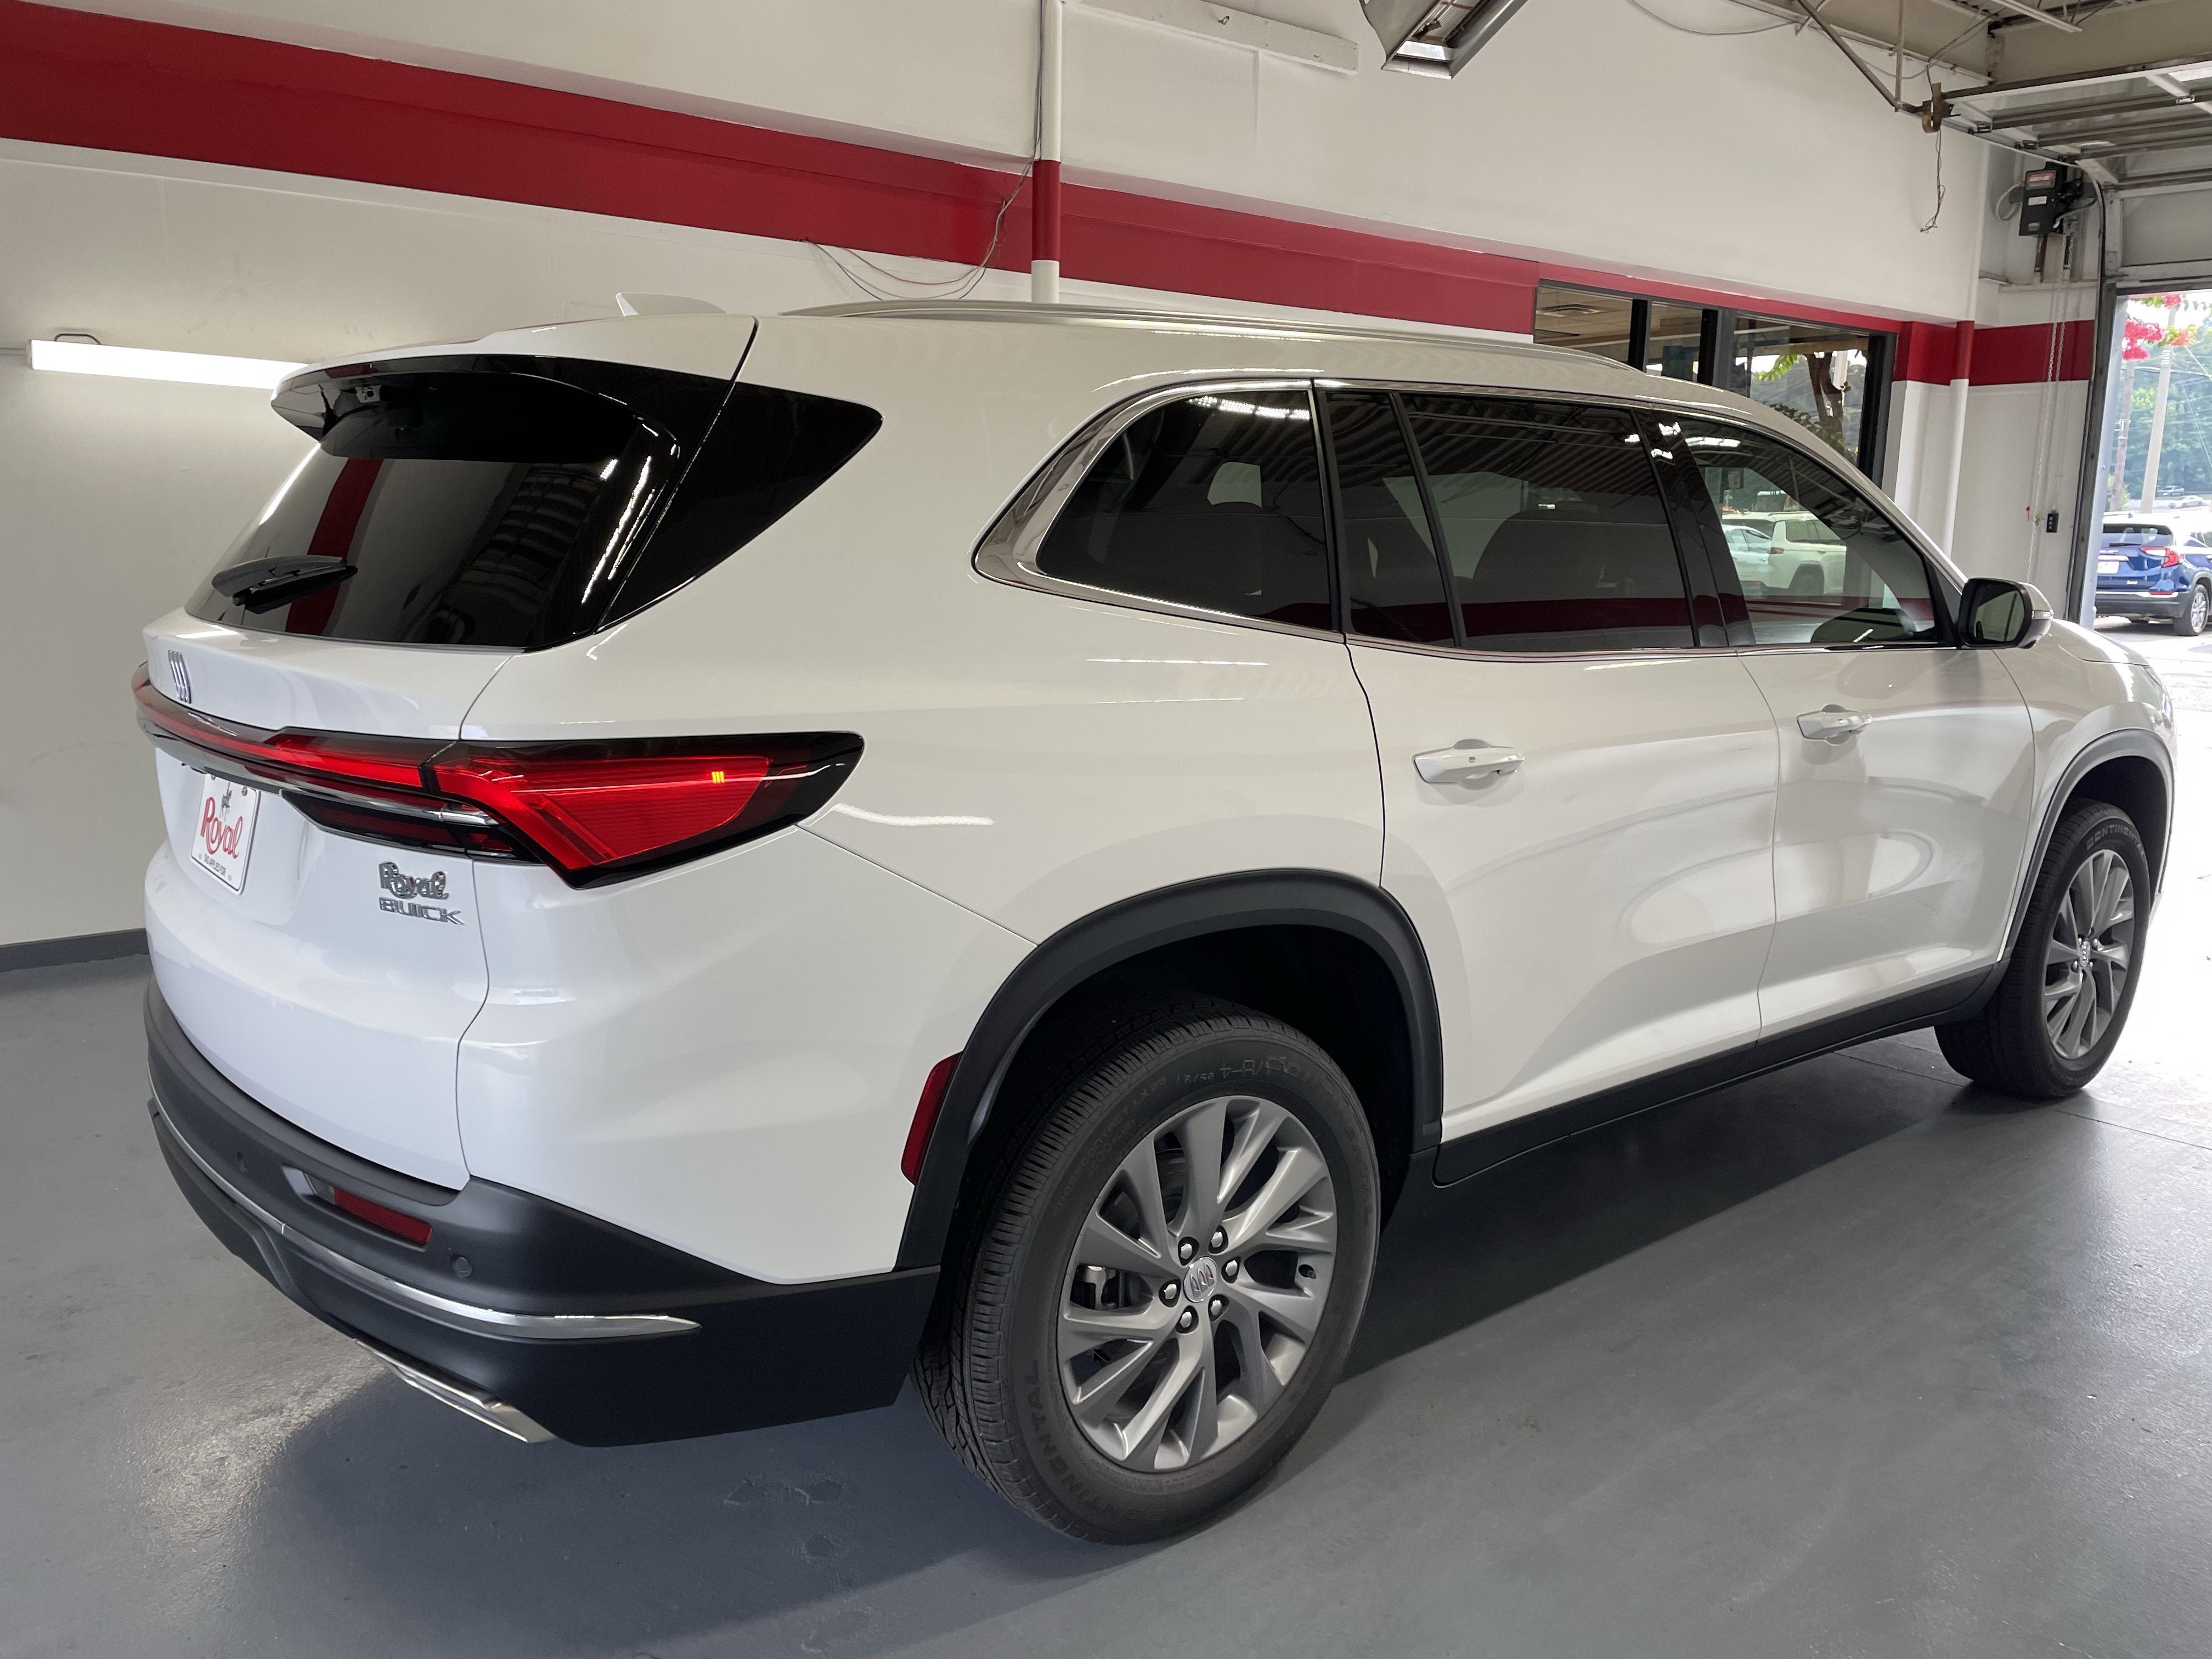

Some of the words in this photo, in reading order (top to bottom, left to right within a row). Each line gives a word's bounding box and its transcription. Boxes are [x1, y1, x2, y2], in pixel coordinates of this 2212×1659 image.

[200, 797, 243, 859] Royal
[379, 861, 449, 900] Royal
[379, 897, 465, 926] BUICK
